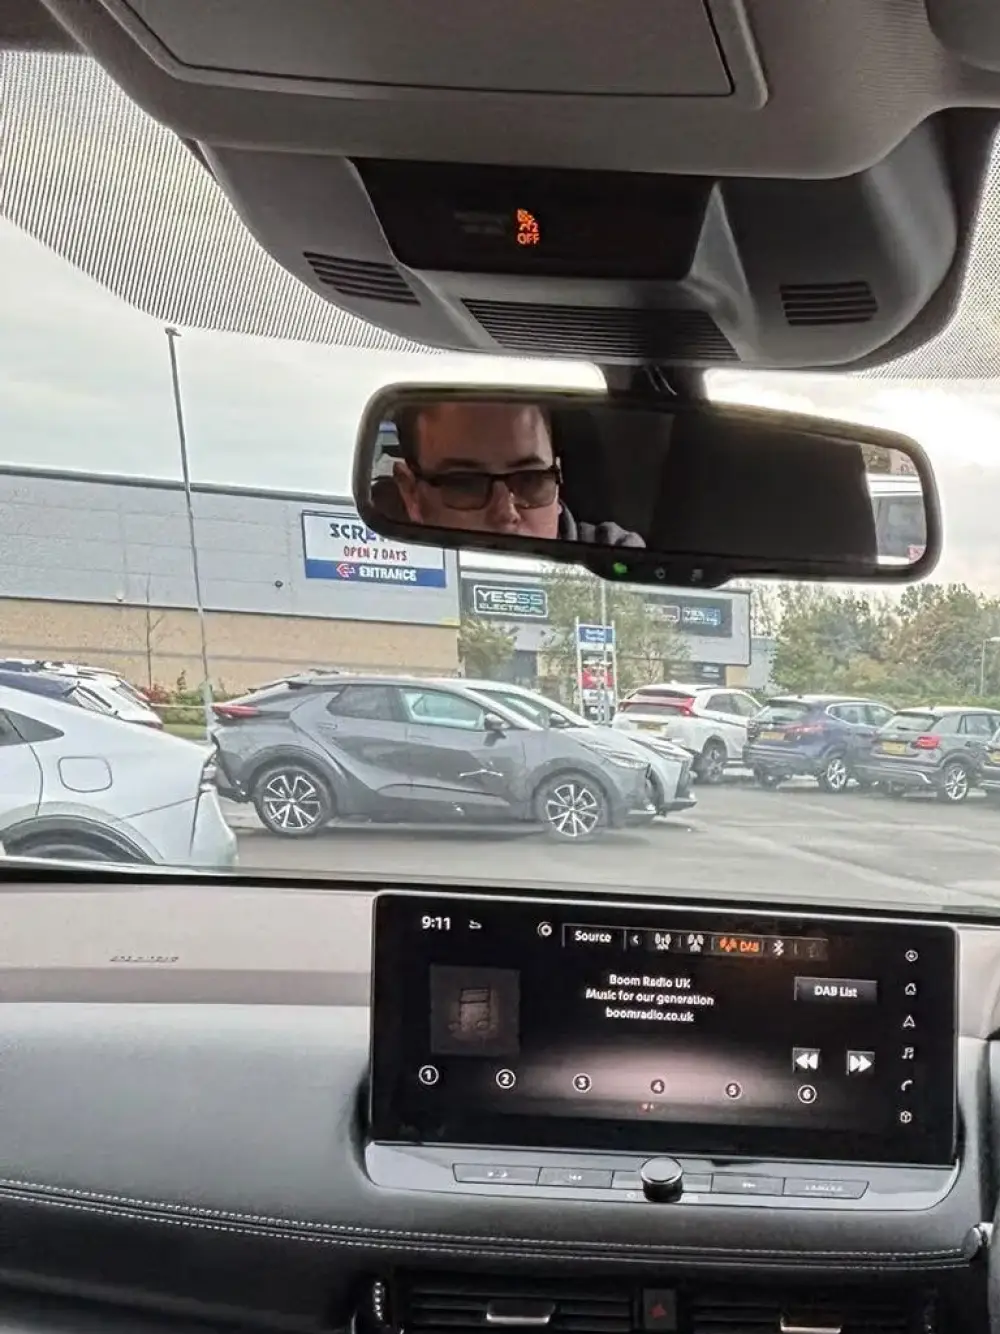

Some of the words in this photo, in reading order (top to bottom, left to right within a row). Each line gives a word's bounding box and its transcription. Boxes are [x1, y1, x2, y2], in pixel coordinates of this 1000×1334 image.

[517, 233, 540, 244] OFF
[343, 546, 371, 559] OPEN
[373, 548, 379, 559] 7
[381, 549, 408, 561] DAYS
[358, 565, 418, 582] ENTRANCE
[478, 589, 543, 605] YESSS
[479, 603, 543, 613] ELECTRICAL
[421, 915, 451, 930] 9:11
[574, 930, 612, 943] Source
[609, 974, 641, 986] Boom
[642, 975, 673, 988] Radio
[674, 977, 692, 989] UK
[585, 989, 617, 1001] Music
[617, 989, 635, 1001] for
[636, 992, 655, 1003] our
[655, 991, 715, 1006] generation
[814, 985, 838, 997] DAB
[839, 986, 858, 998] List
[605, 1007, 695, 1022] boomradio.co.uk
